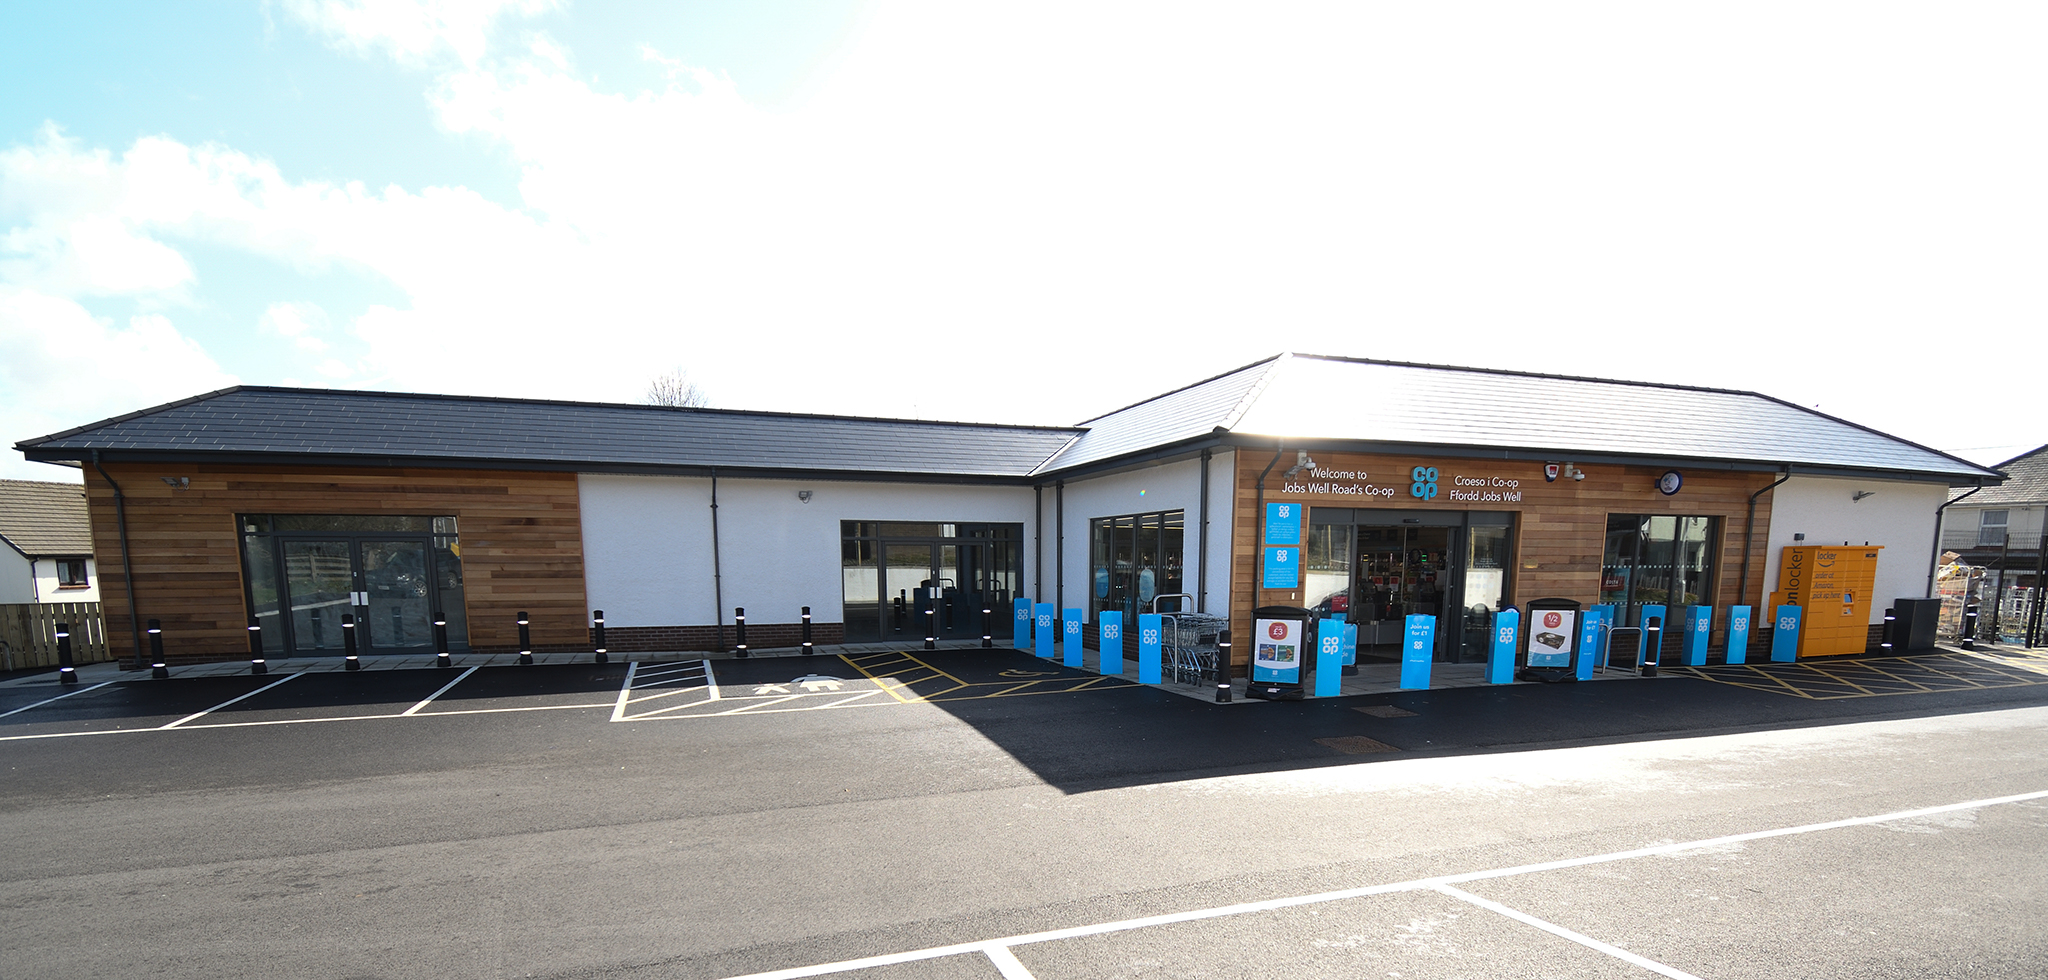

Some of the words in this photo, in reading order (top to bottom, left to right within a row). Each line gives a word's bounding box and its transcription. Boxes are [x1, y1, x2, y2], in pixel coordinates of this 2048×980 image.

[1310, 467, 1355, 480] Welcome
[1357, 470, 1367, 480] to
[1454, 475, 1485, 486] Croeso
[1487, 477, 1491, 486] i
[1491, 476, 1519, 489] Co-op
[1281, 482, 1306, 493] Jobs
[1307, 482, 1329, 494] Well
[1331, 483, 1363, 495] Road's
[1364, 484, 1395, 498] Co-op
[1449, 489, 1479, 501] Ffordd
[1480, 491, 1501, 501] Jobs
[1502, 491, 1522, 502] Well
[1816, 551, 1837, 560] locker
[1272, 628, 1284, 636] £3
